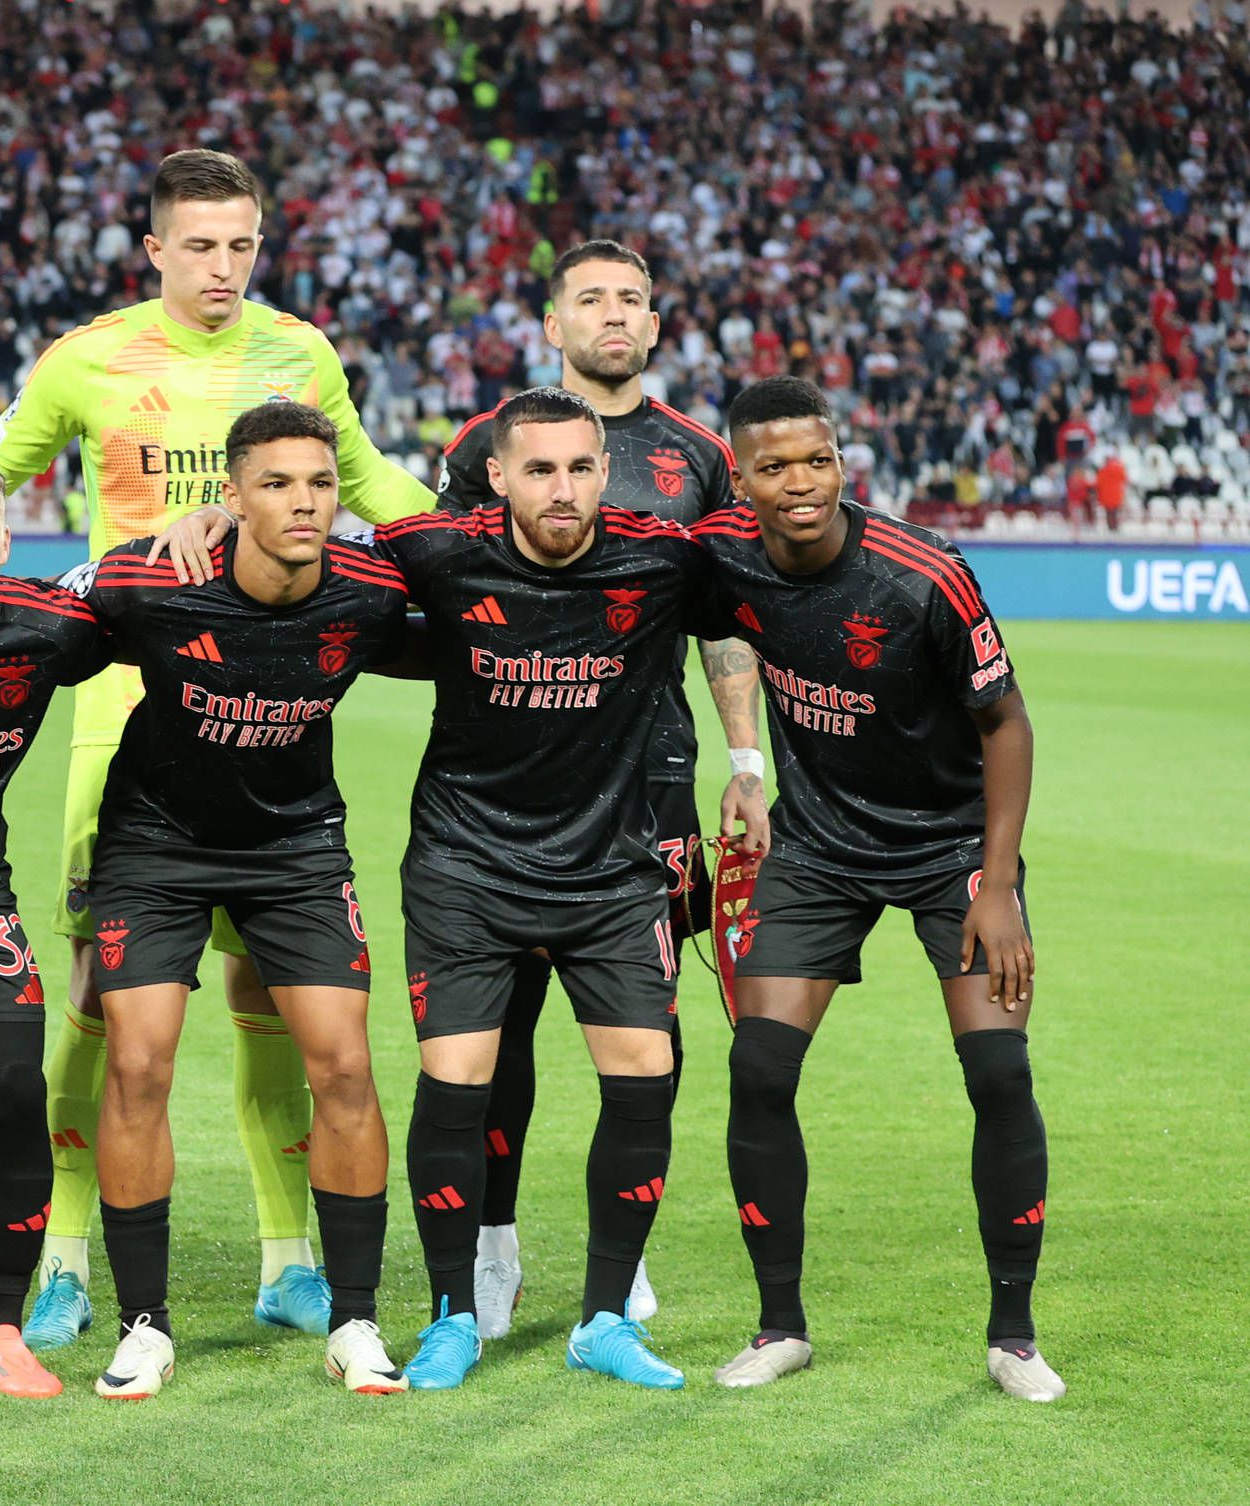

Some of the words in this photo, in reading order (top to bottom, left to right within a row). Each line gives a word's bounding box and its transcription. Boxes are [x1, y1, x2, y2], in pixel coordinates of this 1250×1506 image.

[165, 481, 194, 505] FLY
[1106, 558, 1250, 613] UEFA
[469, 646, 624, 682] Emirates
[182, 681, 334, 723] Emirates
[489, 683, 526, 708] FLY
[528, 683, 600, 709] BETTER
[756, 653, 877, 715] mirates
[197, 718, 236, 745] FLY
[236, 723, 307, 748] BETTER
[793, 700, 856, 737] BETTER
